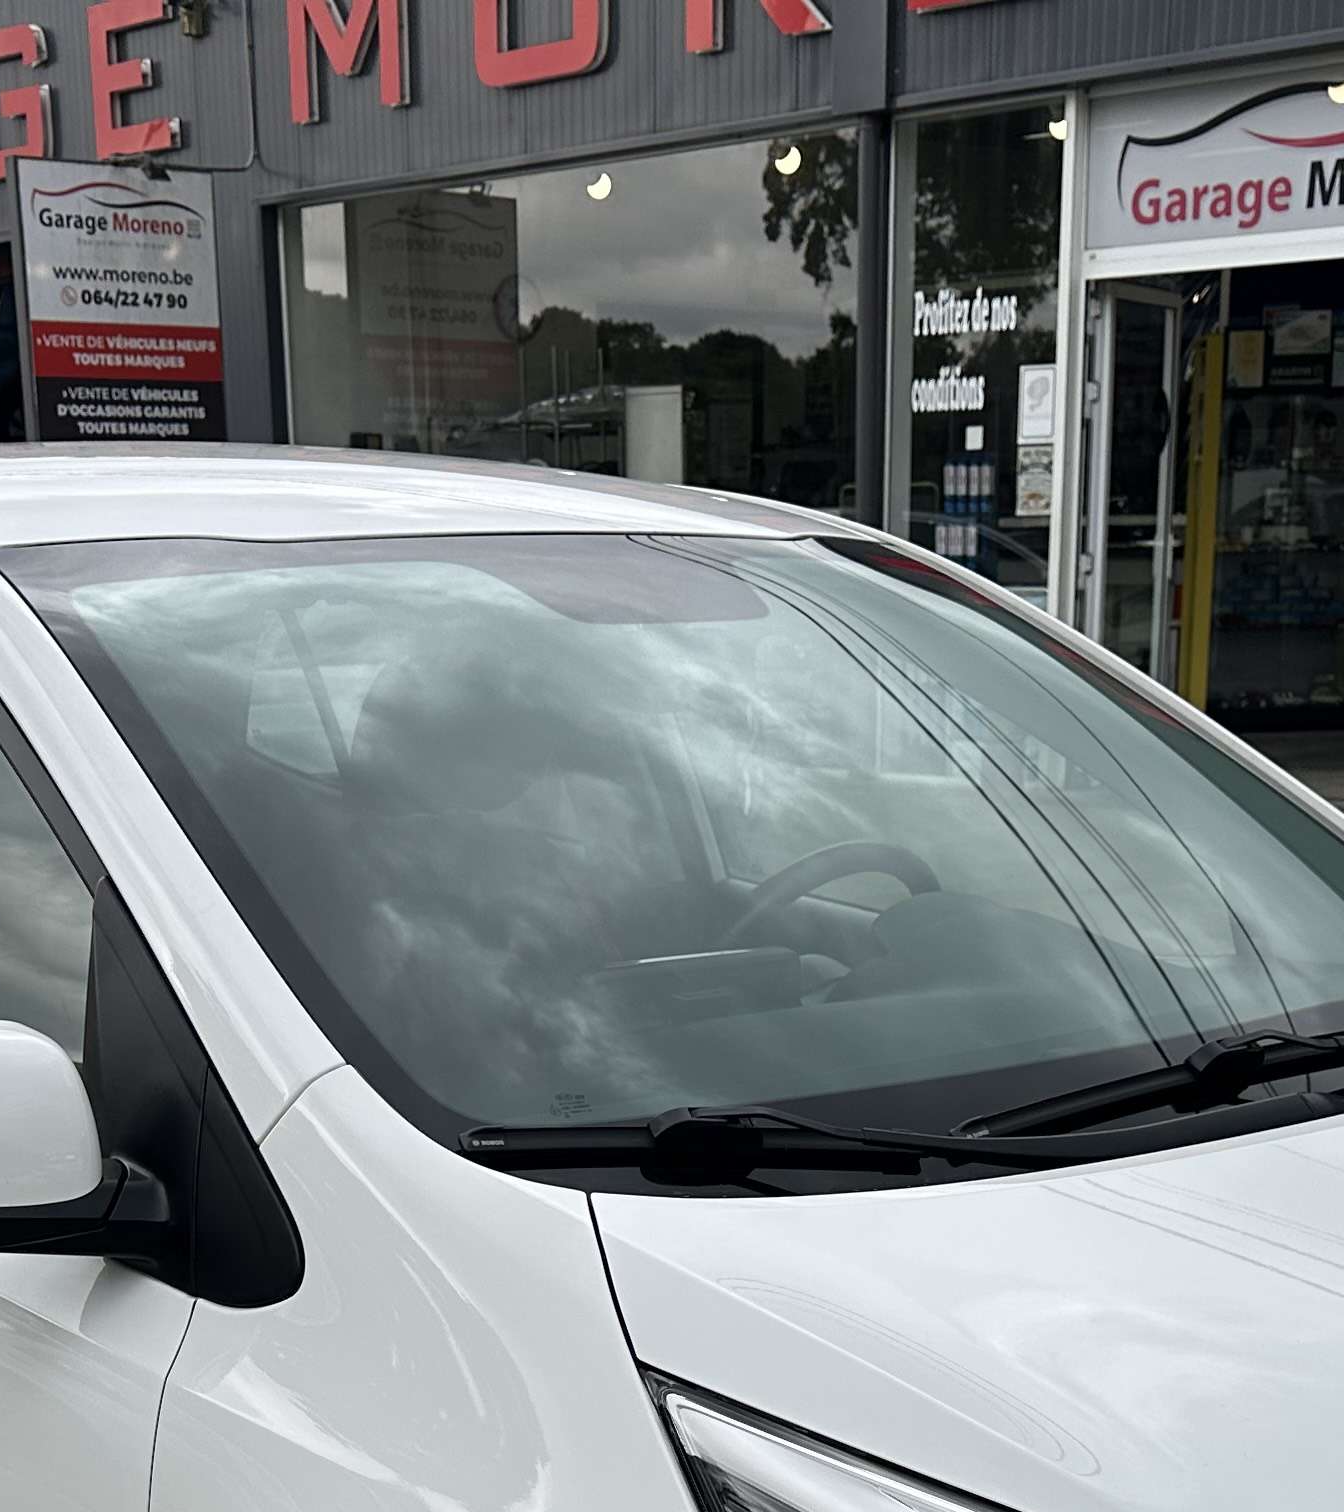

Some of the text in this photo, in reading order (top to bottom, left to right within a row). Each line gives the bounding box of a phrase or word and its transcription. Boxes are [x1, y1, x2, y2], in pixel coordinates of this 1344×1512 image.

[1131, 176, 1293, 229] Garage
[39, 208, 108, 235] Garage
[112, 212, 184, 236] Moreno
[52, 266, 194, 286] www.moreno.be
[81, 289, 188, 309] 064/22 47 90
[914, 286, 1017, 336] Profitez de nos
[42, 334, 84, 347] VENTE
[87, 336, 104, 348] DE
[176, 339, 217, 352] NEUFS
[73, 353, 185, 369] TOUTES MARQUES
[70, 387, 110, 400] VENTE
[112, 389, 129, 400] DE
[911, 365, 985, 413] conditions
[57, 404, 206, 419] D'OCCASIONS GARANTIS
[78, 421, 190, 437] TOUTES MARQUES
